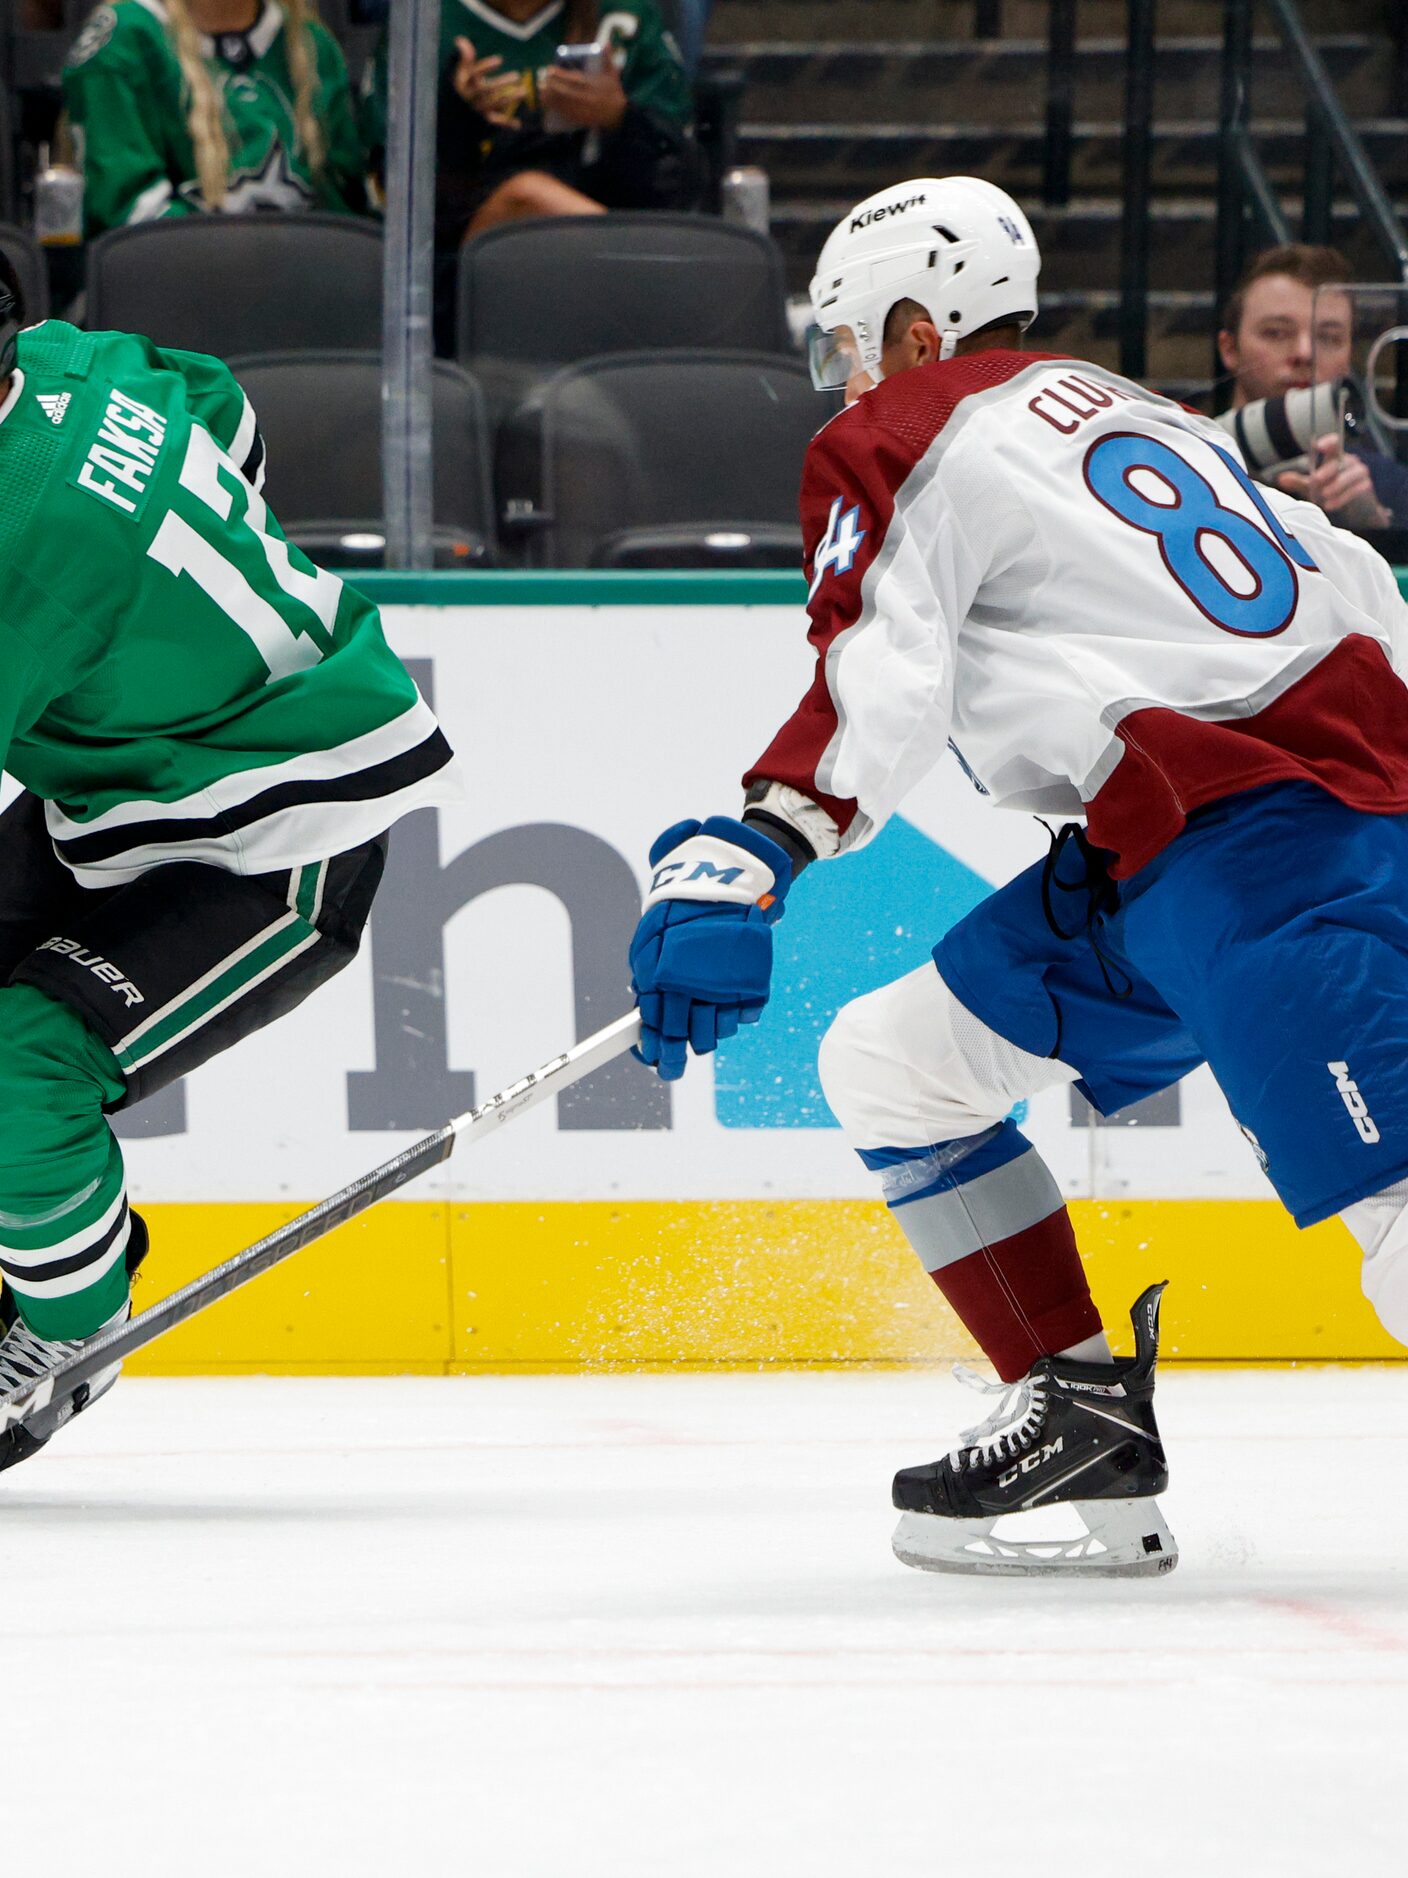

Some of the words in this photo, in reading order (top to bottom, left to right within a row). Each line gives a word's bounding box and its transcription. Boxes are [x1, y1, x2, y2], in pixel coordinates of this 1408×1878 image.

[849, 194, 927, 234] Kiewit
[51, 391, 72, 425] adidas
[1028, 374, 1141, 435] CLU
[77, 388, 168, 513] FAKSA
[146, 422, 344, 686] 12
[1083, 431, 1320, 638] 8
[1327, 1060, 1380, 1144] CCM
[1146, 1303, 1156, 1340] CCM
[997, 1436, 1064, 1488] CCM
